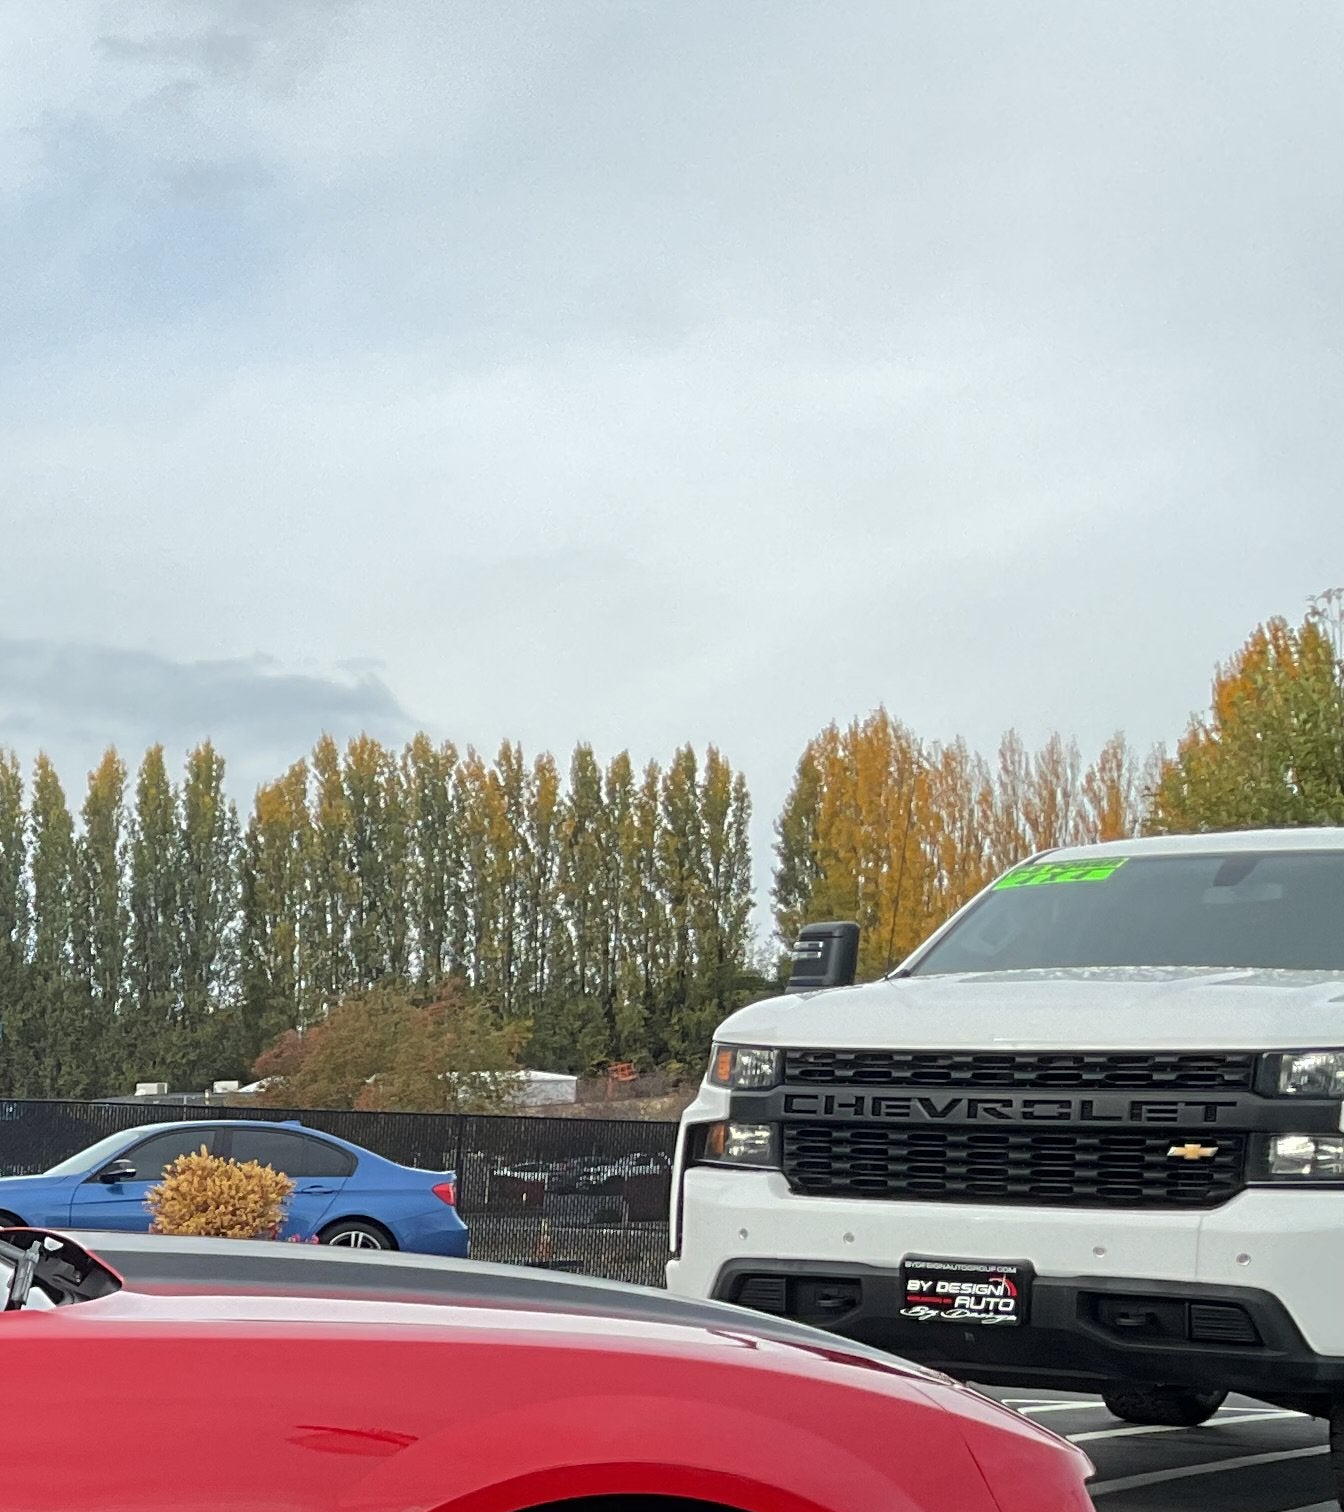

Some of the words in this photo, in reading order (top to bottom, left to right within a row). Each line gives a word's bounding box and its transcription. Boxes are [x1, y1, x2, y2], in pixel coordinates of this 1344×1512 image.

[783, 1093, 1238, 1123] CHEVROLET
[907, 1280, 932, 1291] BY
[936, 1282, 1003, 1295] DESIGN
[955, 1296, 1015, 1311] AUTO
